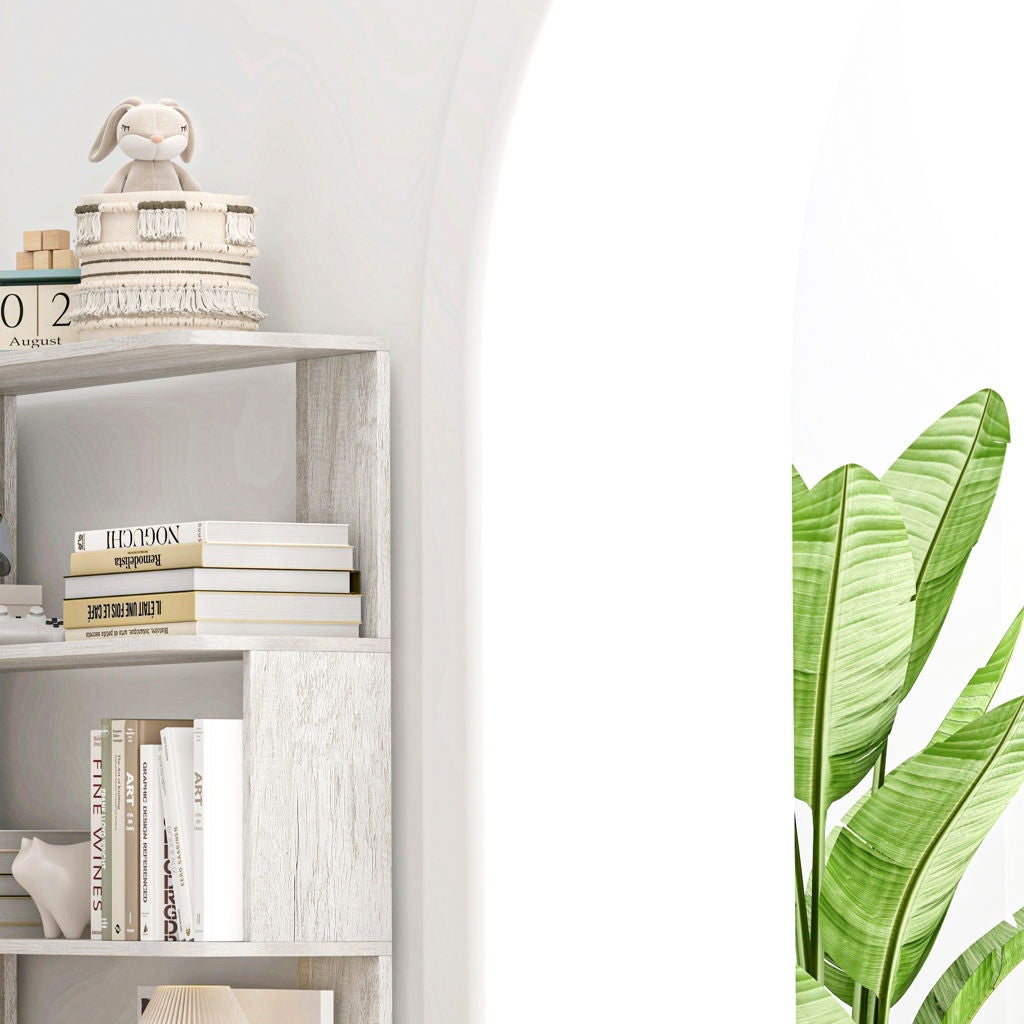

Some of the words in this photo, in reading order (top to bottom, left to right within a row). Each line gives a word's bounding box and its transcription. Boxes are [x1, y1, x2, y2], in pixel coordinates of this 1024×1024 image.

[52, 292, 71, 326] 2
[9, 336, 62, 349] August
[106, 525, 180, 549] NOGUCHI
[114, 554, 161, 569] Remodelista
[87, 604, 103, 622] CAFÉ
[103, 604, 111, 618] LE
[111, 603, 124, 618] FOIS
[125, 602, 137, 617] UNE
[93, 759, 102, 814] FINE
[126, 772, 134, 806] ART
[194, 772, 203, 806] ART
[93, 827, 102, 911] WINES
